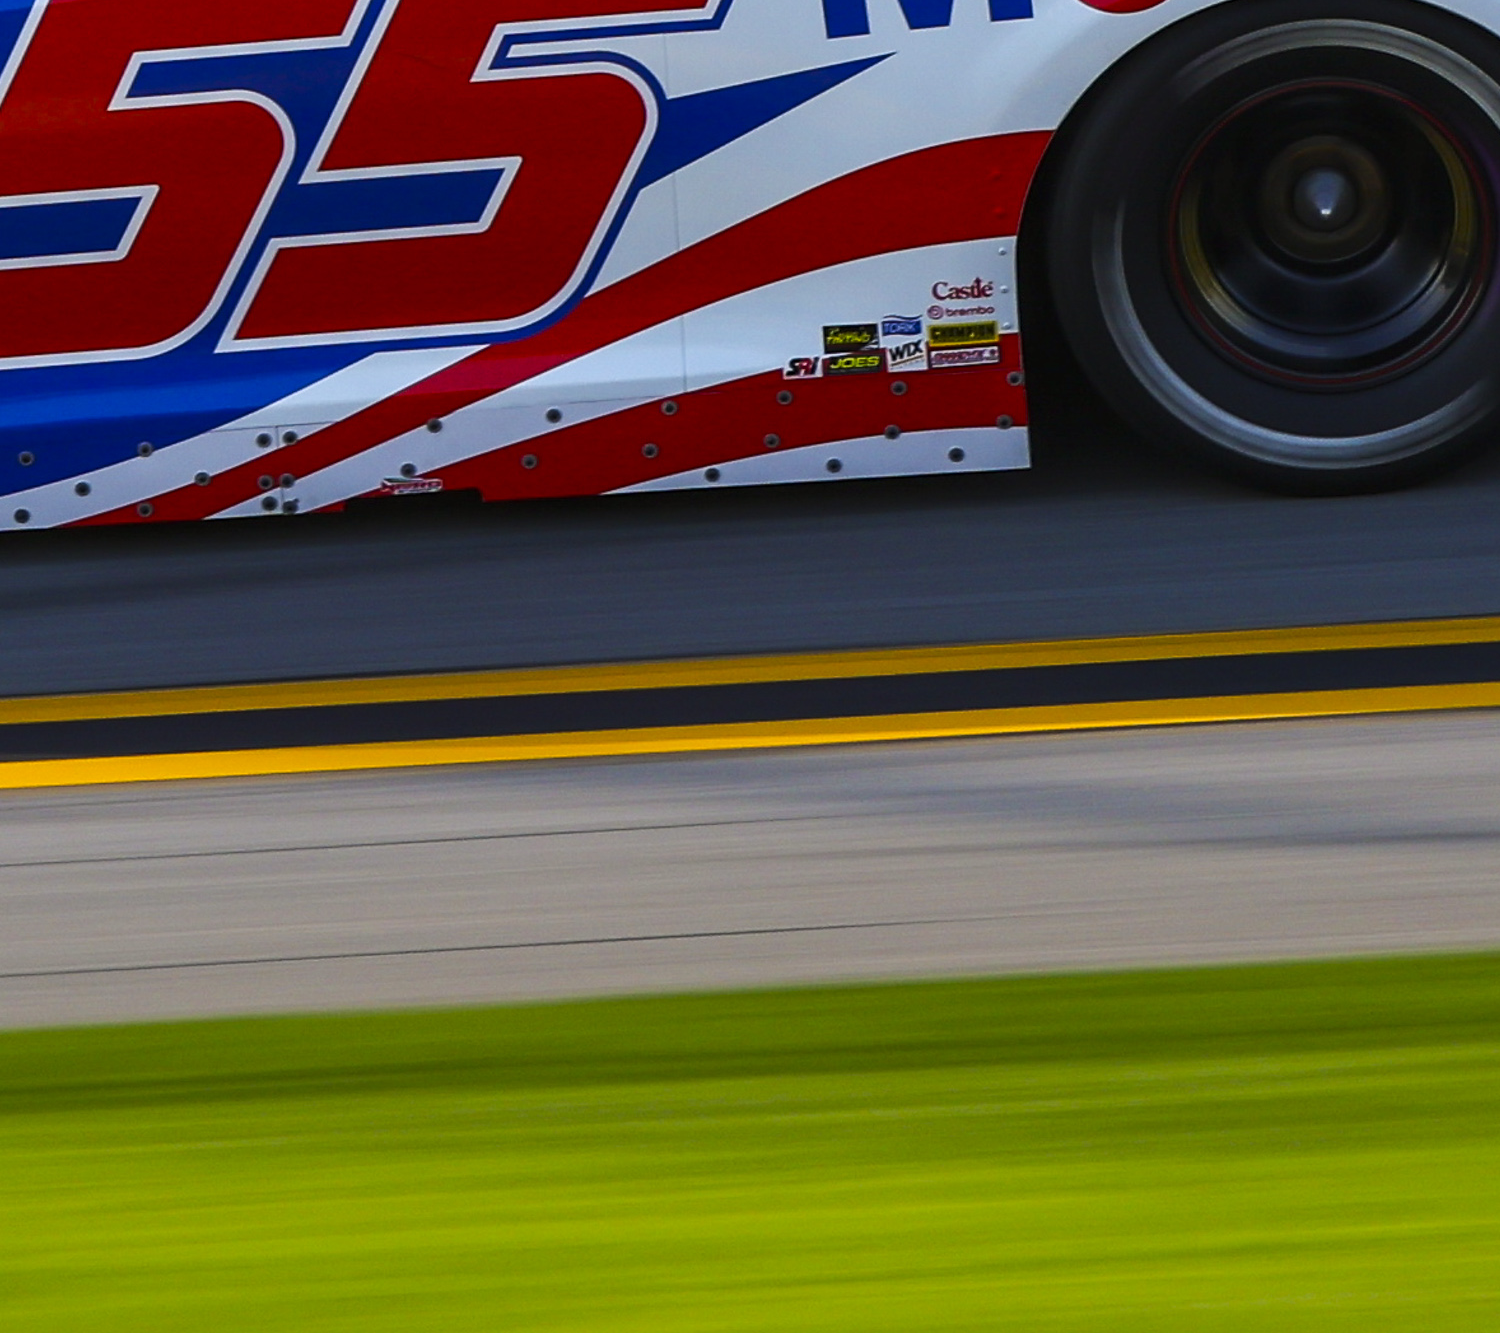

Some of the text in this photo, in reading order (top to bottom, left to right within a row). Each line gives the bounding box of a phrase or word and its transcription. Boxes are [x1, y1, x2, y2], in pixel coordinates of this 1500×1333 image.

[931, 277, 995, 301] Castle
[889, 339, 923, 361] WIX
[830, 355, 880, 369] JOES
